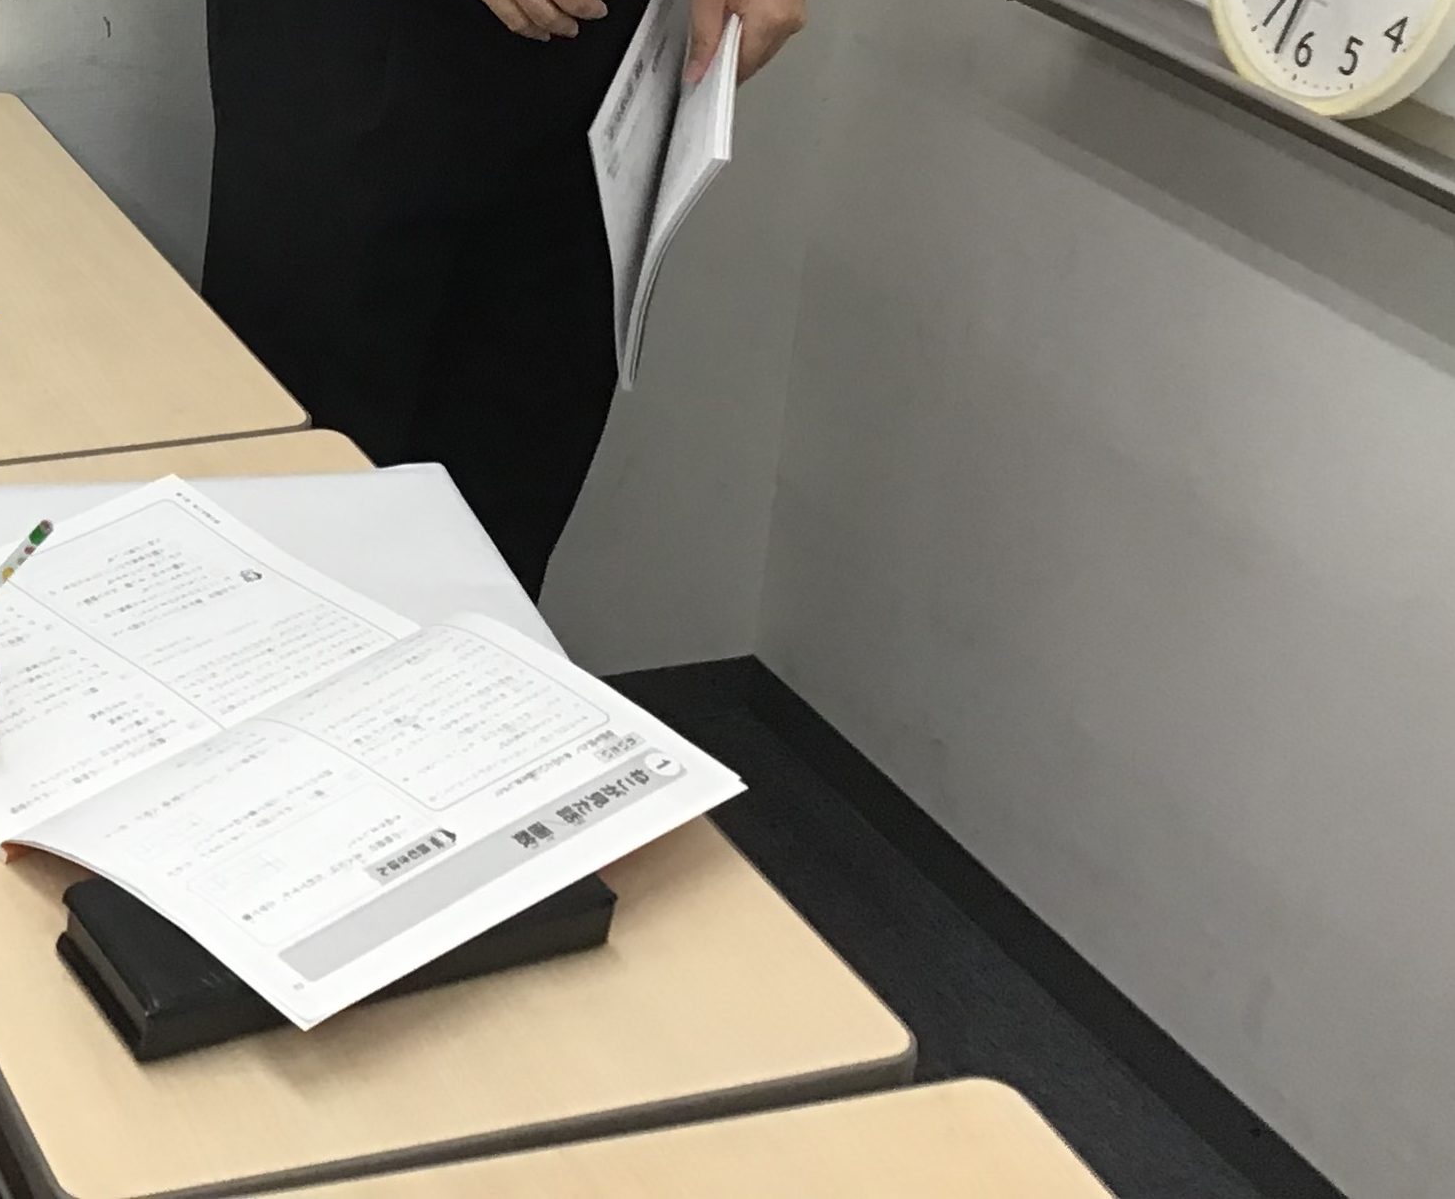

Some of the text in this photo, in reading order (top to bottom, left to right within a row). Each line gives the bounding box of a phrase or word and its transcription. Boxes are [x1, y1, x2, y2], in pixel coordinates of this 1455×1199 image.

[1294, 31, 1316, 69] 6
[1384, 16, 1409, 54] 4
[1337, 35, 1364, 77] 5
